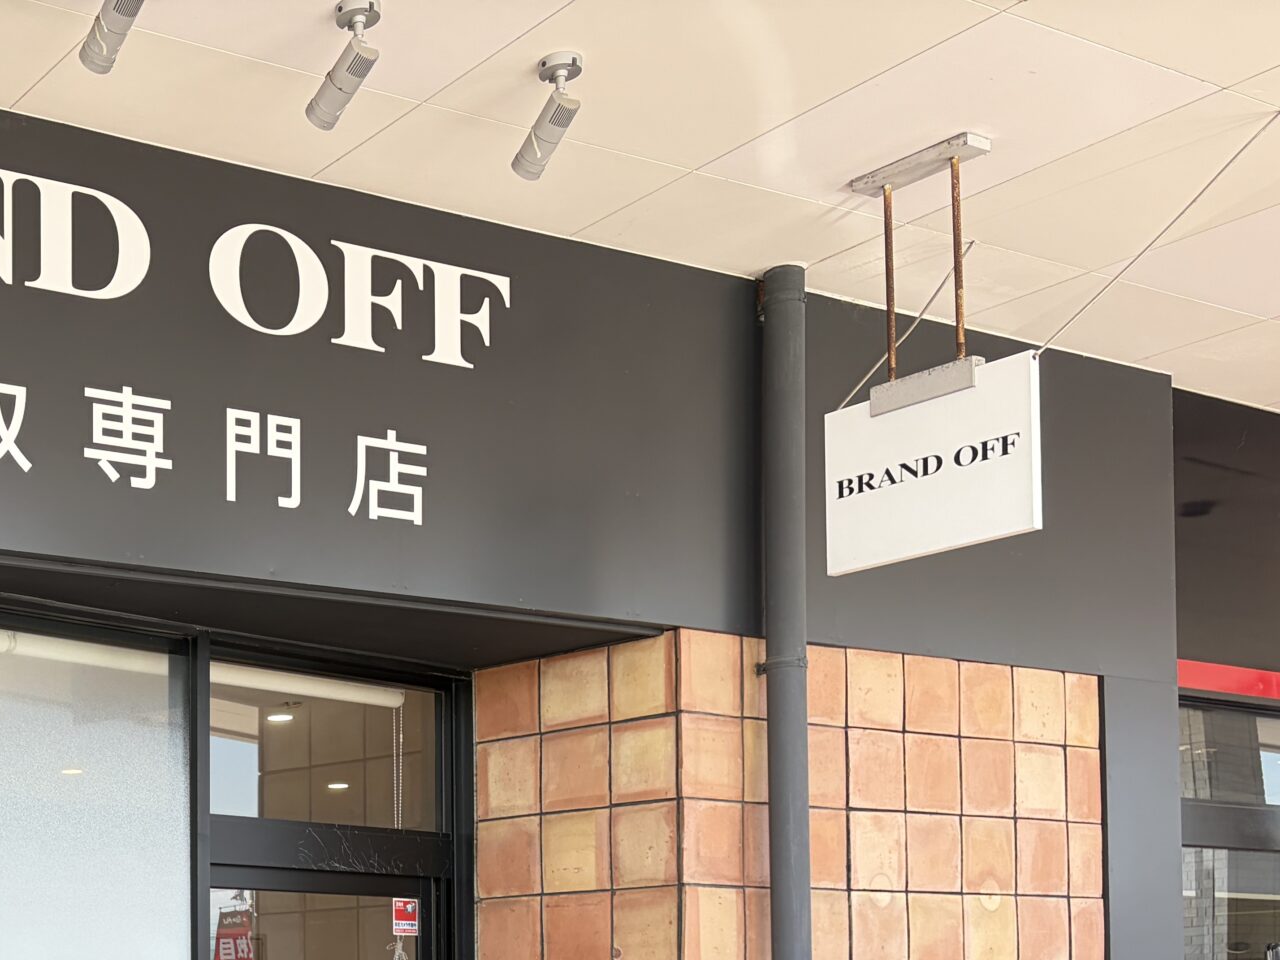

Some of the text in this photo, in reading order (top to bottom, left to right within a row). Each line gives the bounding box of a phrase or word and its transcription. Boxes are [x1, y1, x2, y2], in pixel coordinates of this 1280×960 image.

[208, 223, 511, 369] OFF
[836, 432, 1021, 500] BRAND OFF
